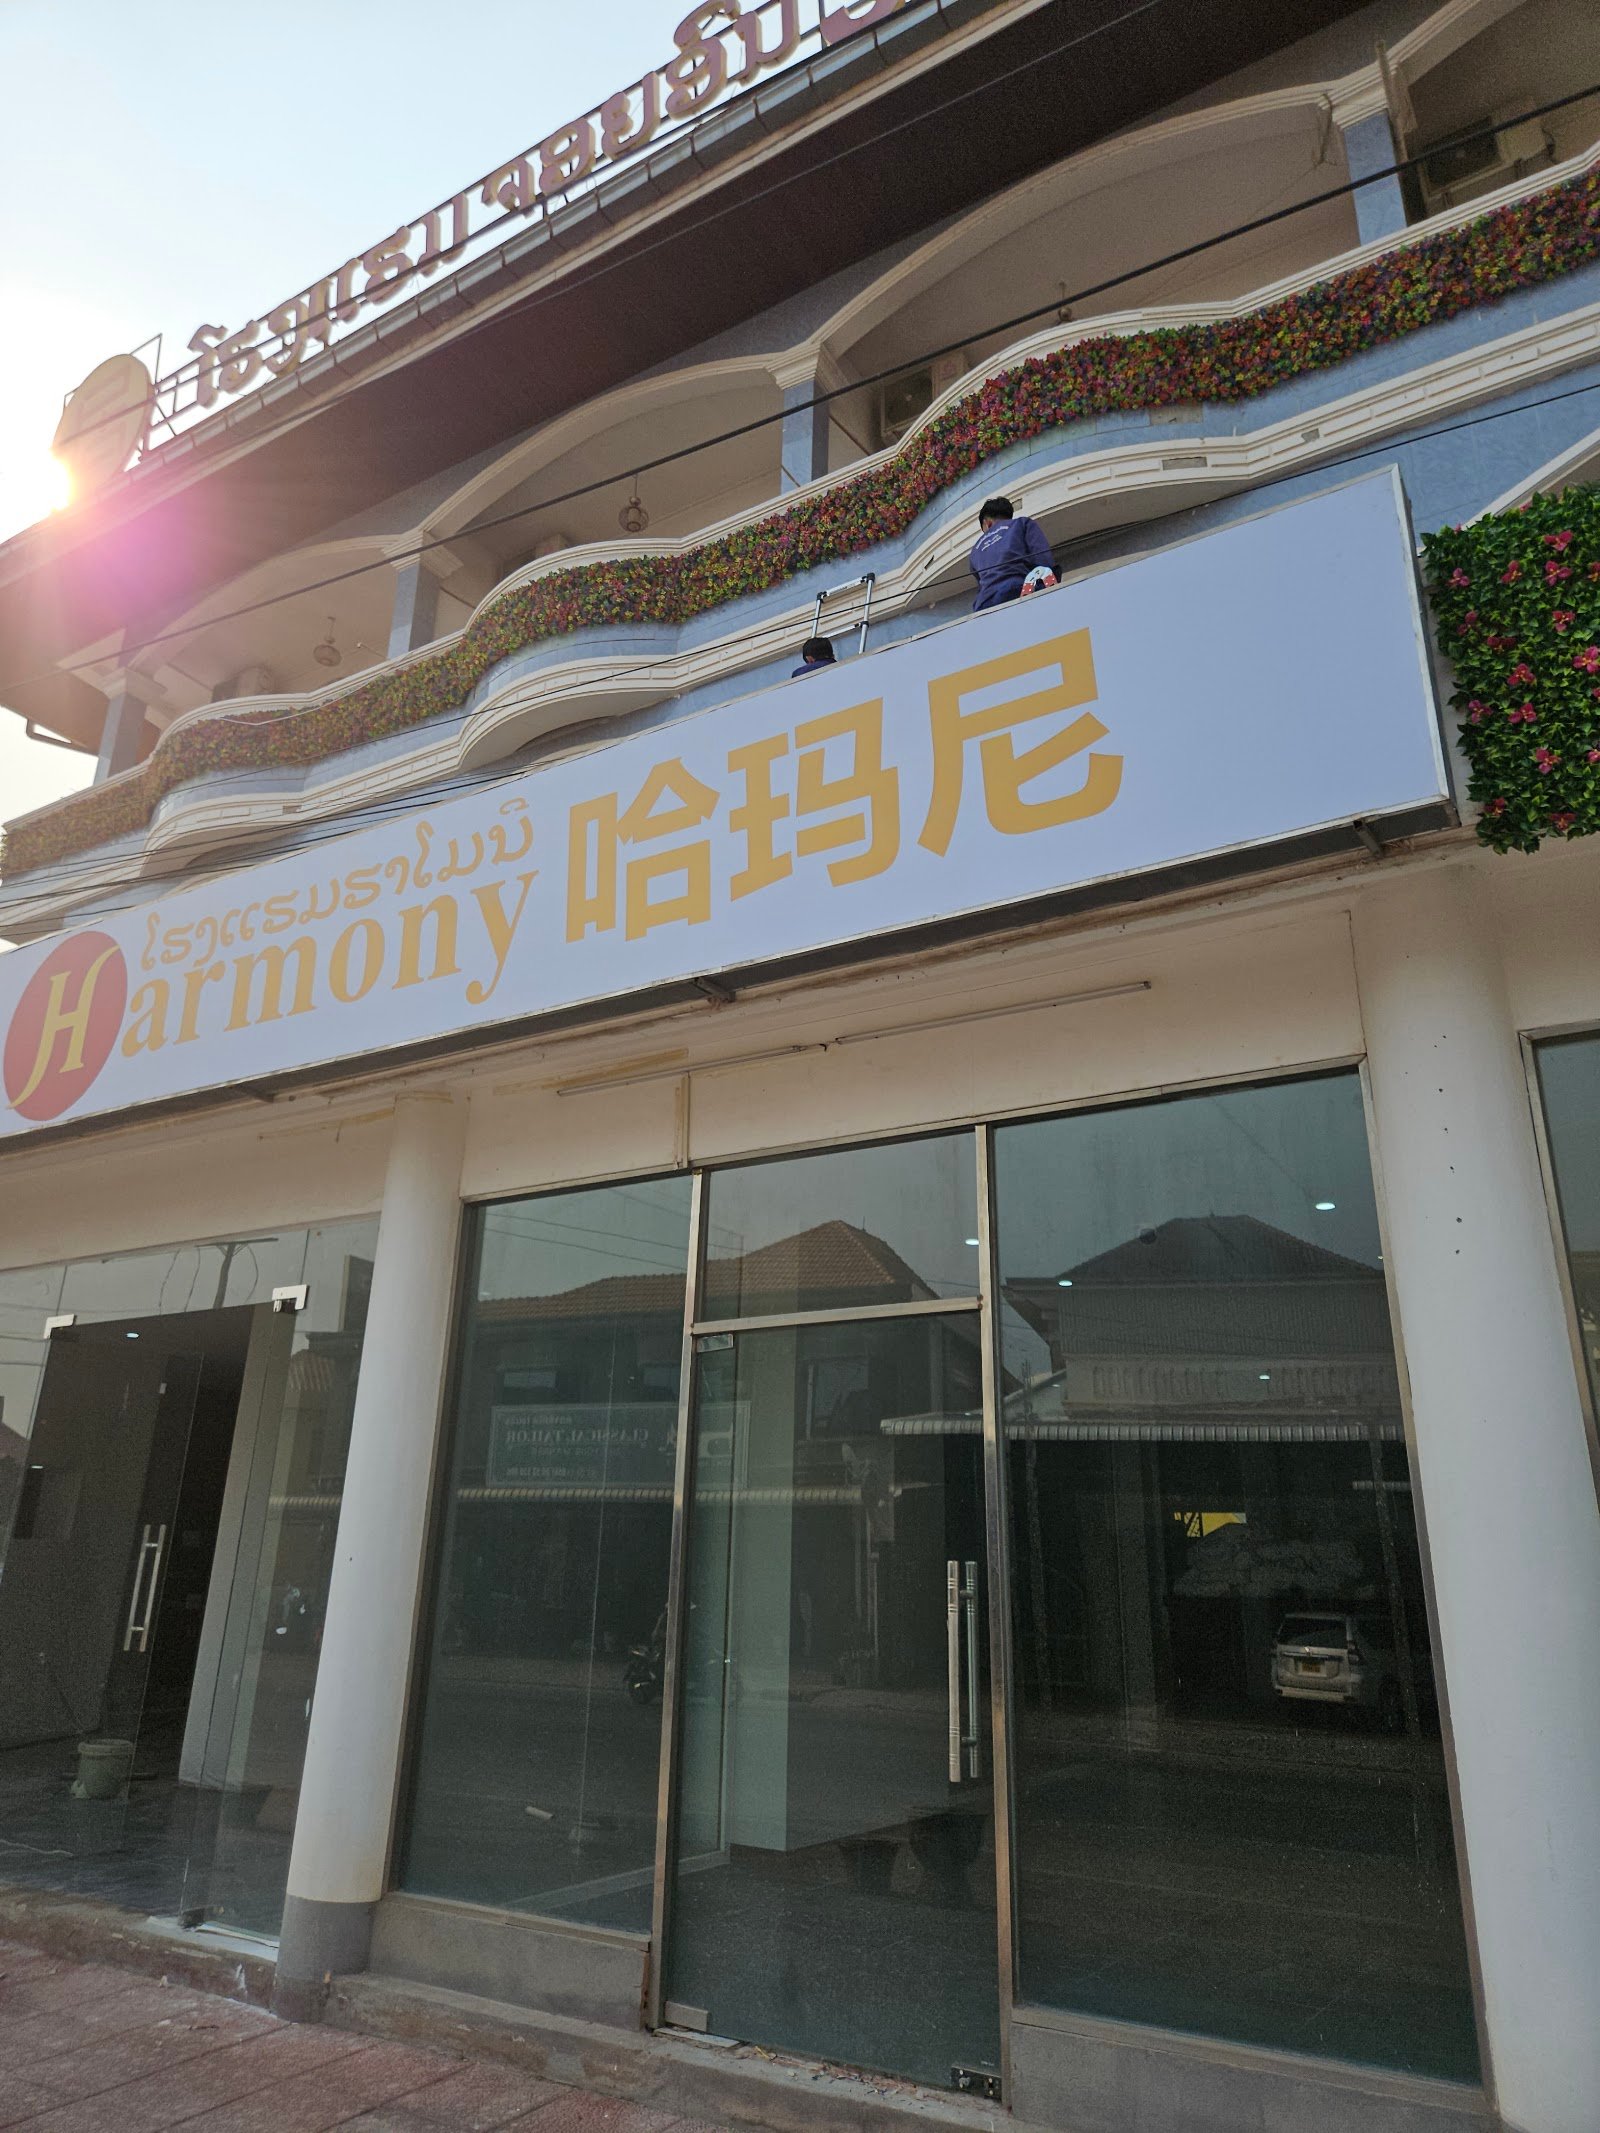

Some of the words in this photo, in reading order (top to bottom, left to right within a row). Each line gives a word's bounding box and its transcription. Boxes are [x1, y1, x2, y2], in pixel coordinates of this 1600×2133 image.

[566, 627, 1124, 942] 哈玛尼
[9, 869, 539, 1109] Harmony
